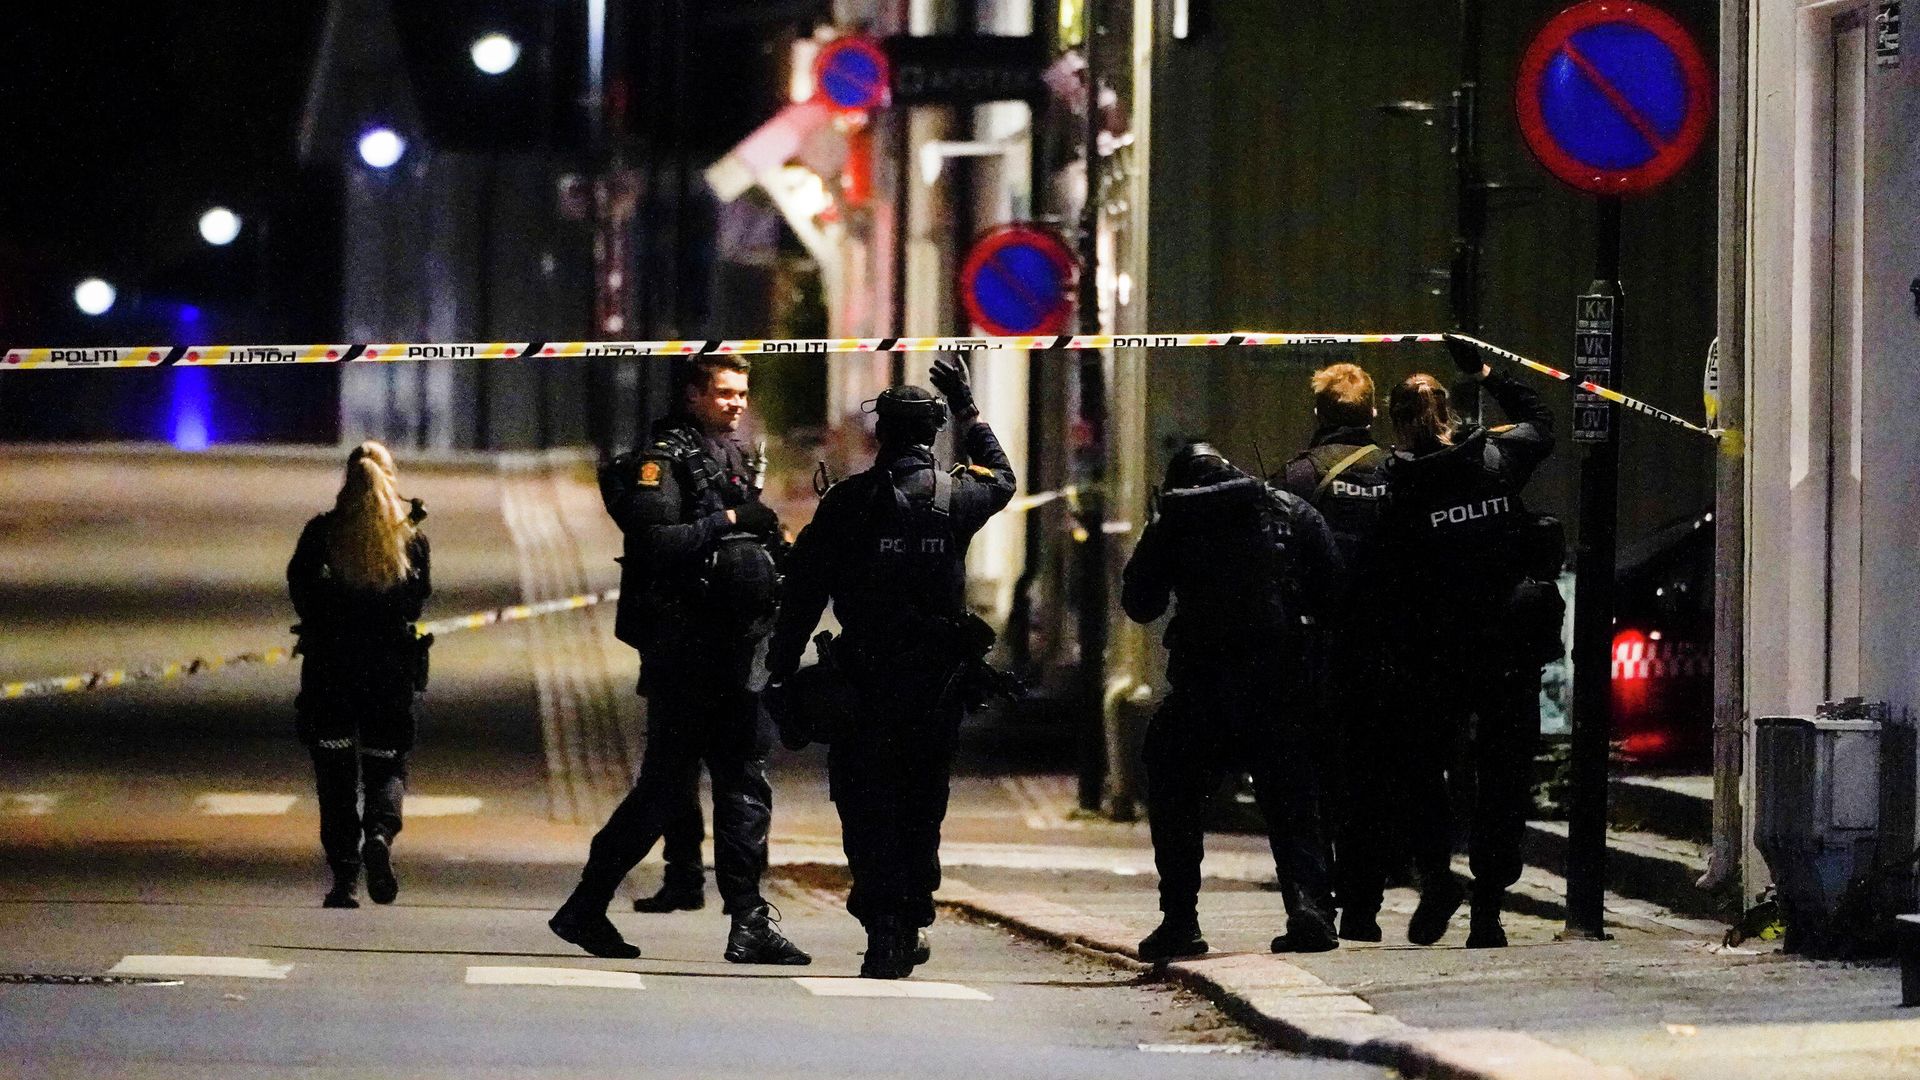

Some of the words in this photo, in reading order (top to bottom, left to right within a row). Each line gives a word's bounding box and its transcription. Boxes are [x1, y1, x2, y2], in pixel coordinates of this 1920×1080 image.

[1586, 300, 1608, 319] KK
[409, 346, 475, 358] POLITI
[1584, 337, 1605, 355] VK
[51, 350, 118, 363] POLITI
[229, 351, 296, 364] POLITI
[1333, 480, 1387, 497] POLIT
[1430, 496, 1510, 528] POLITI
[880, 538, 945, 553] POITI
